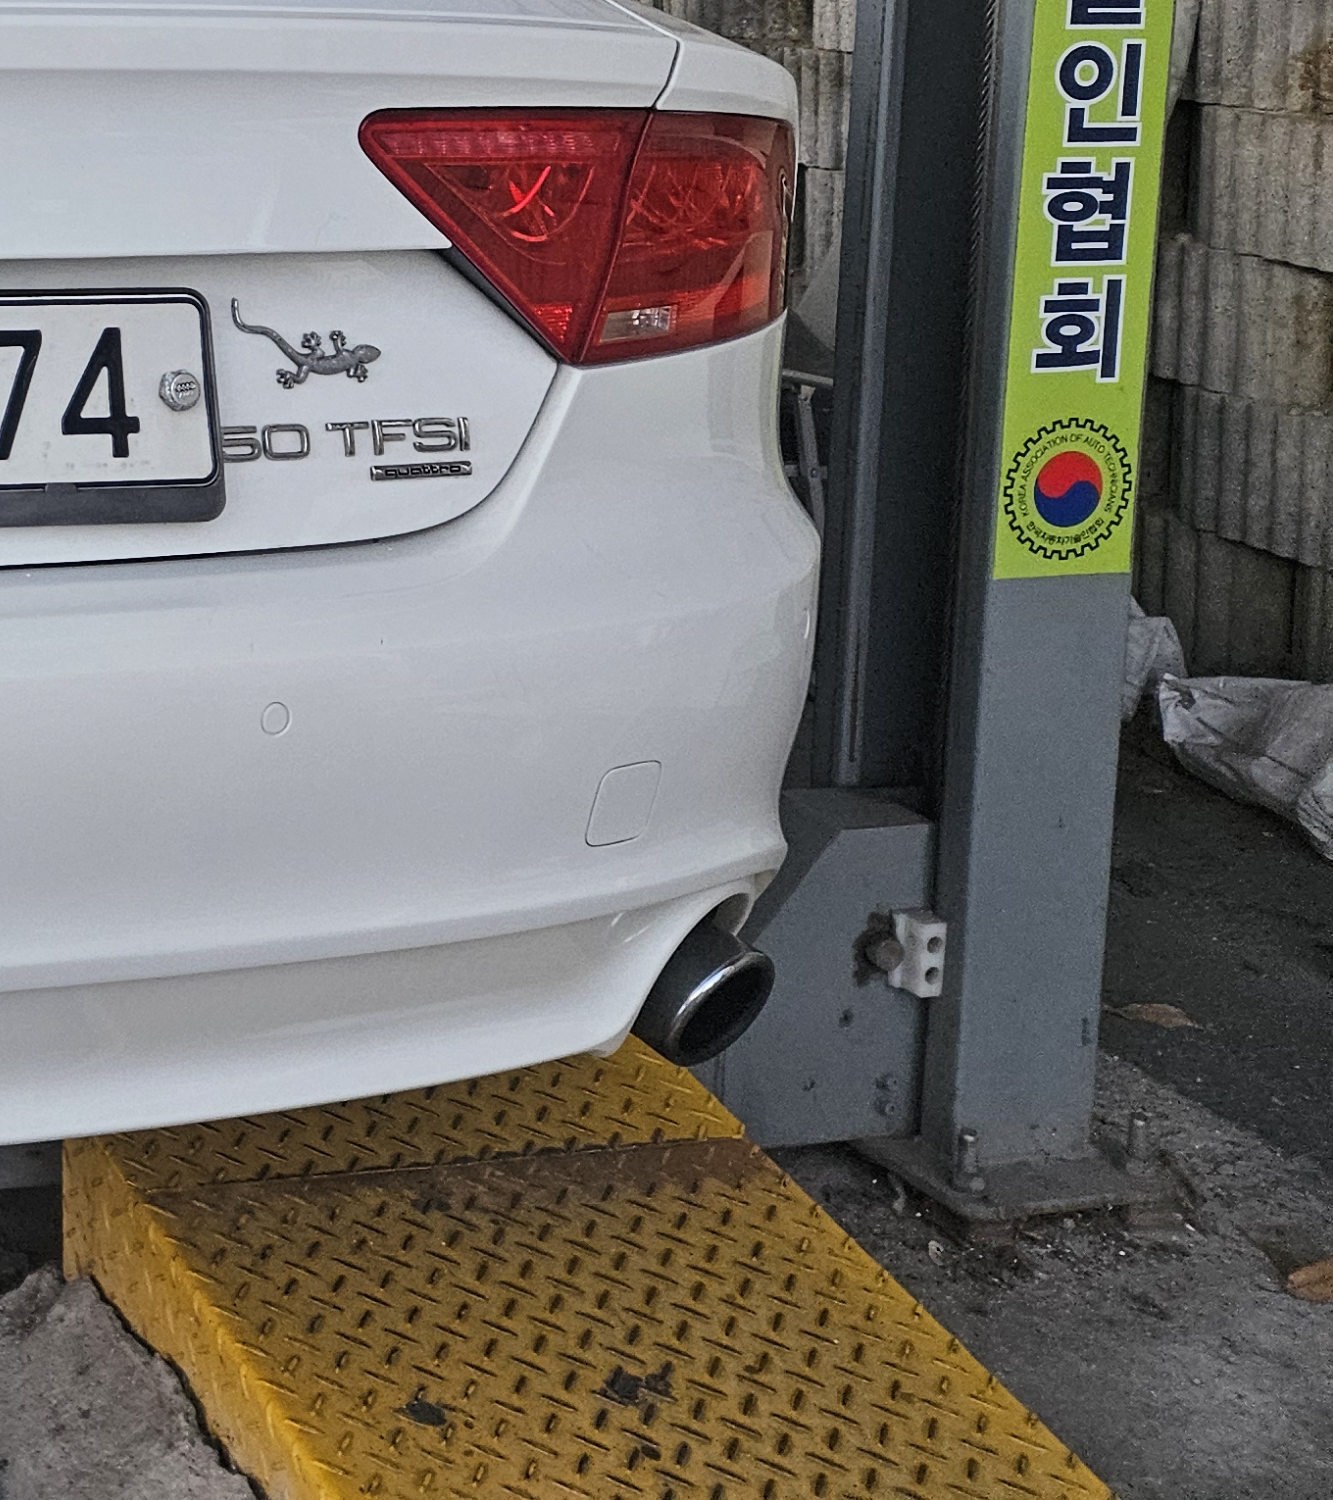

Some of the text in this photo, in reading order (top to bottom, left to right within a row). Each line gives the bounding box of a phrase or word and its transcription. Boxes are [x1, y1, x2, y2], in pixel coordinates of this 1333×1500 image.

[325, 416, 471, 457] TFSI
[383, 463, 462, 479] quattro
[1021, 434, 1068, 482] ASSOCIATION
[1069, 433, 1083, 443] OF
[1083, 436, 1106, 454] AUTO
